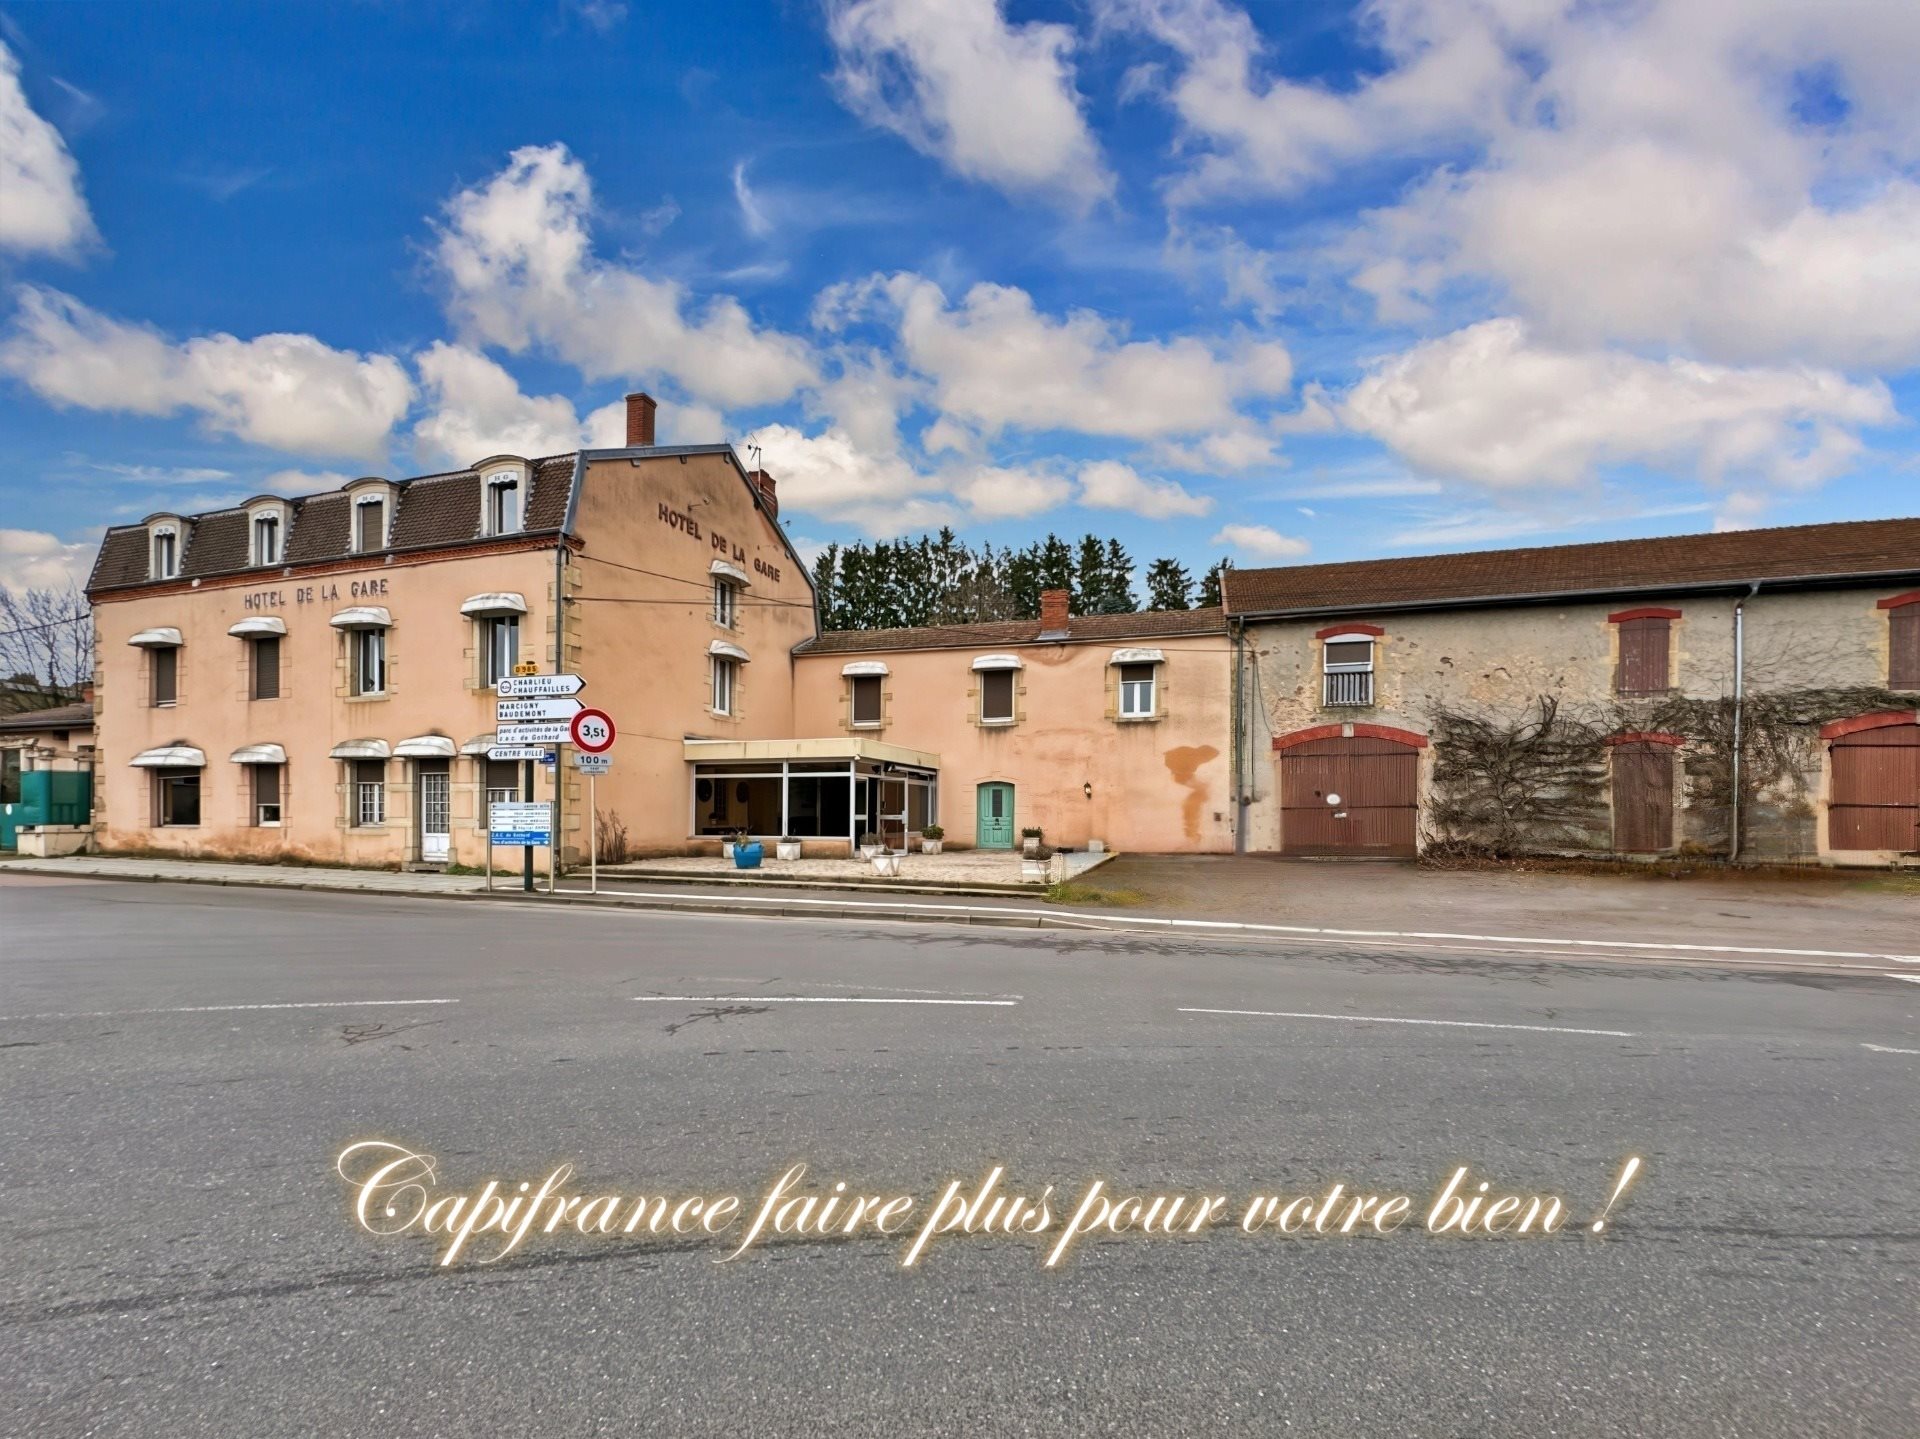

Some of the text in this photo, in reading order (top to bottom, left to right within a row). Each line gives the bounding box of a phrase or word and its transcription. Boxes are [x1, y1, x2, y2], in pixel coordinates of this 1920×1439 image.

[658, 502, 780, 583] HOTEL DE LA GARE
[244, 578, 389, 609] HOTEL DE LA GARE
[513, 678, 552, 686] CHARLIEU
[513, 685, 570, 694] CHAUFFAILLES
[499, 702, 539, 710] MARCIGNY
[499, 710, 546, 718] BAUDEMONT
[582, 724, 606, 739] 3,5t
[494, 749, 543, 758] CENTRE VILLE
[580, 756, 599, 764] 100
